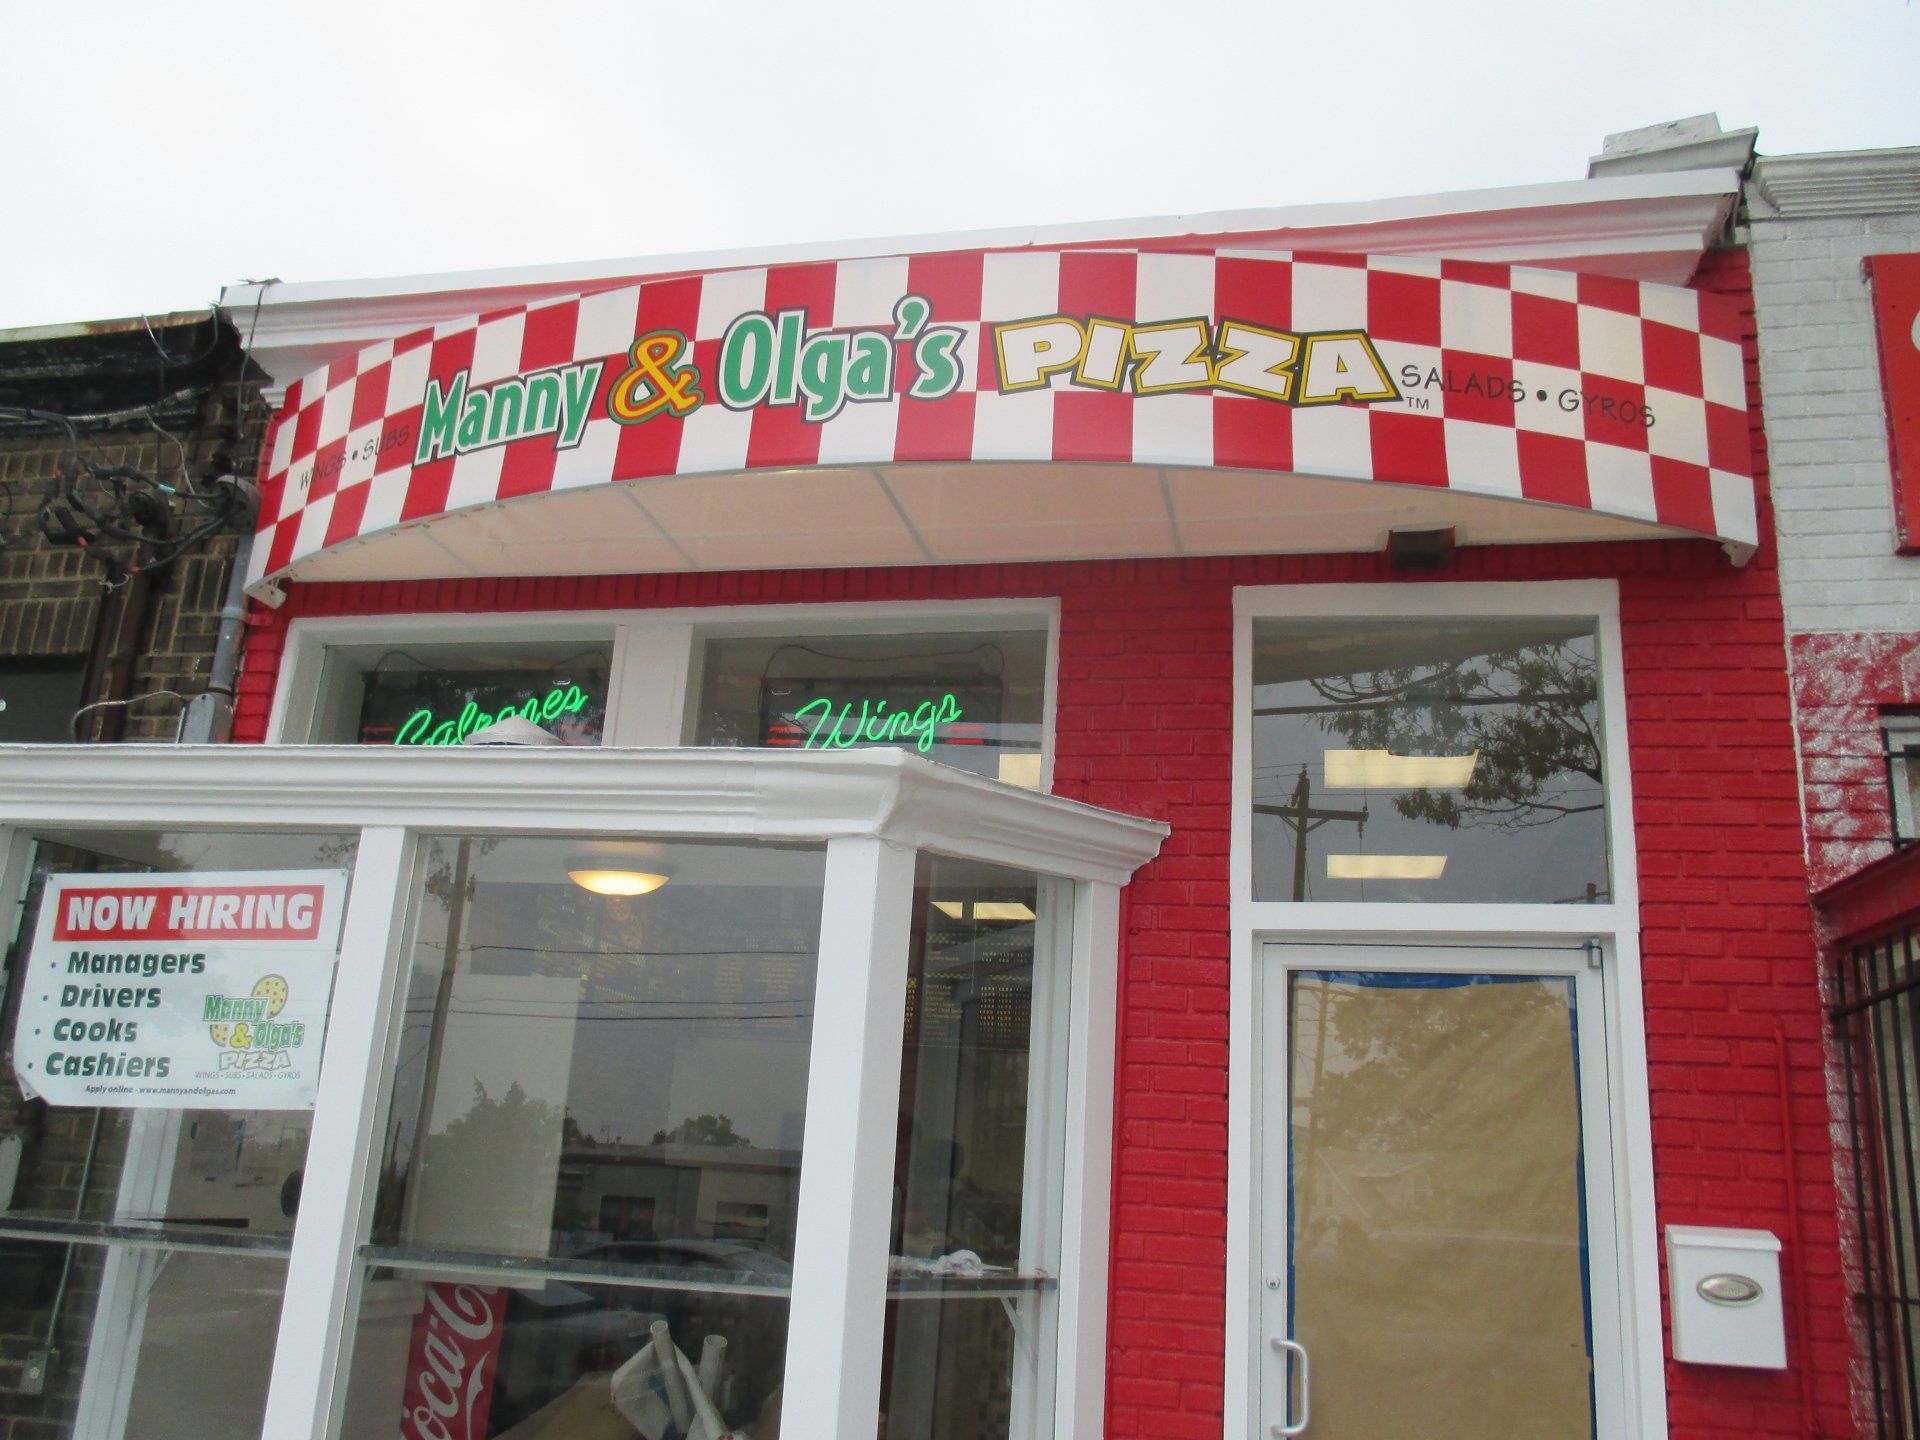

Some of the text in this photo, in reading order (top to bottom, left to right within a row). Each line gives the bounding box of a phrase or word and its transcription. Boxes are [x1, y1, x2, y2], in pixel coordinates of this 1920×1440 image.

[412, 293, 1403, 469] Manny & Olga's PIZZA
[1400, 364, 1656, 428] SALADS GYROS
[1405, 396, 1429, 410] TM
[300, 425, 411, 490] WINGS SUBS
[795, 694, 963, 752] Wings
[66, 893, 315, 931] NOW HIRING
[67, 951, 206, 977] Managers
[60, 983, 162, 1009] Drivers
[203, 995, 269, 1026] Manny
[53, 1017, 138, 1042] Cooks
[45, 1051, 171, 1078] Cashiers
[219, 1050, 291, 1071] PIZZA
[195, 1071, 301, 1080] WINGS SUBS SALADS GYROS
[85, 1085, 236, 1097] Apply online www.mannyandolgas.com
[400, 1284, 498, 1440] oca-C
